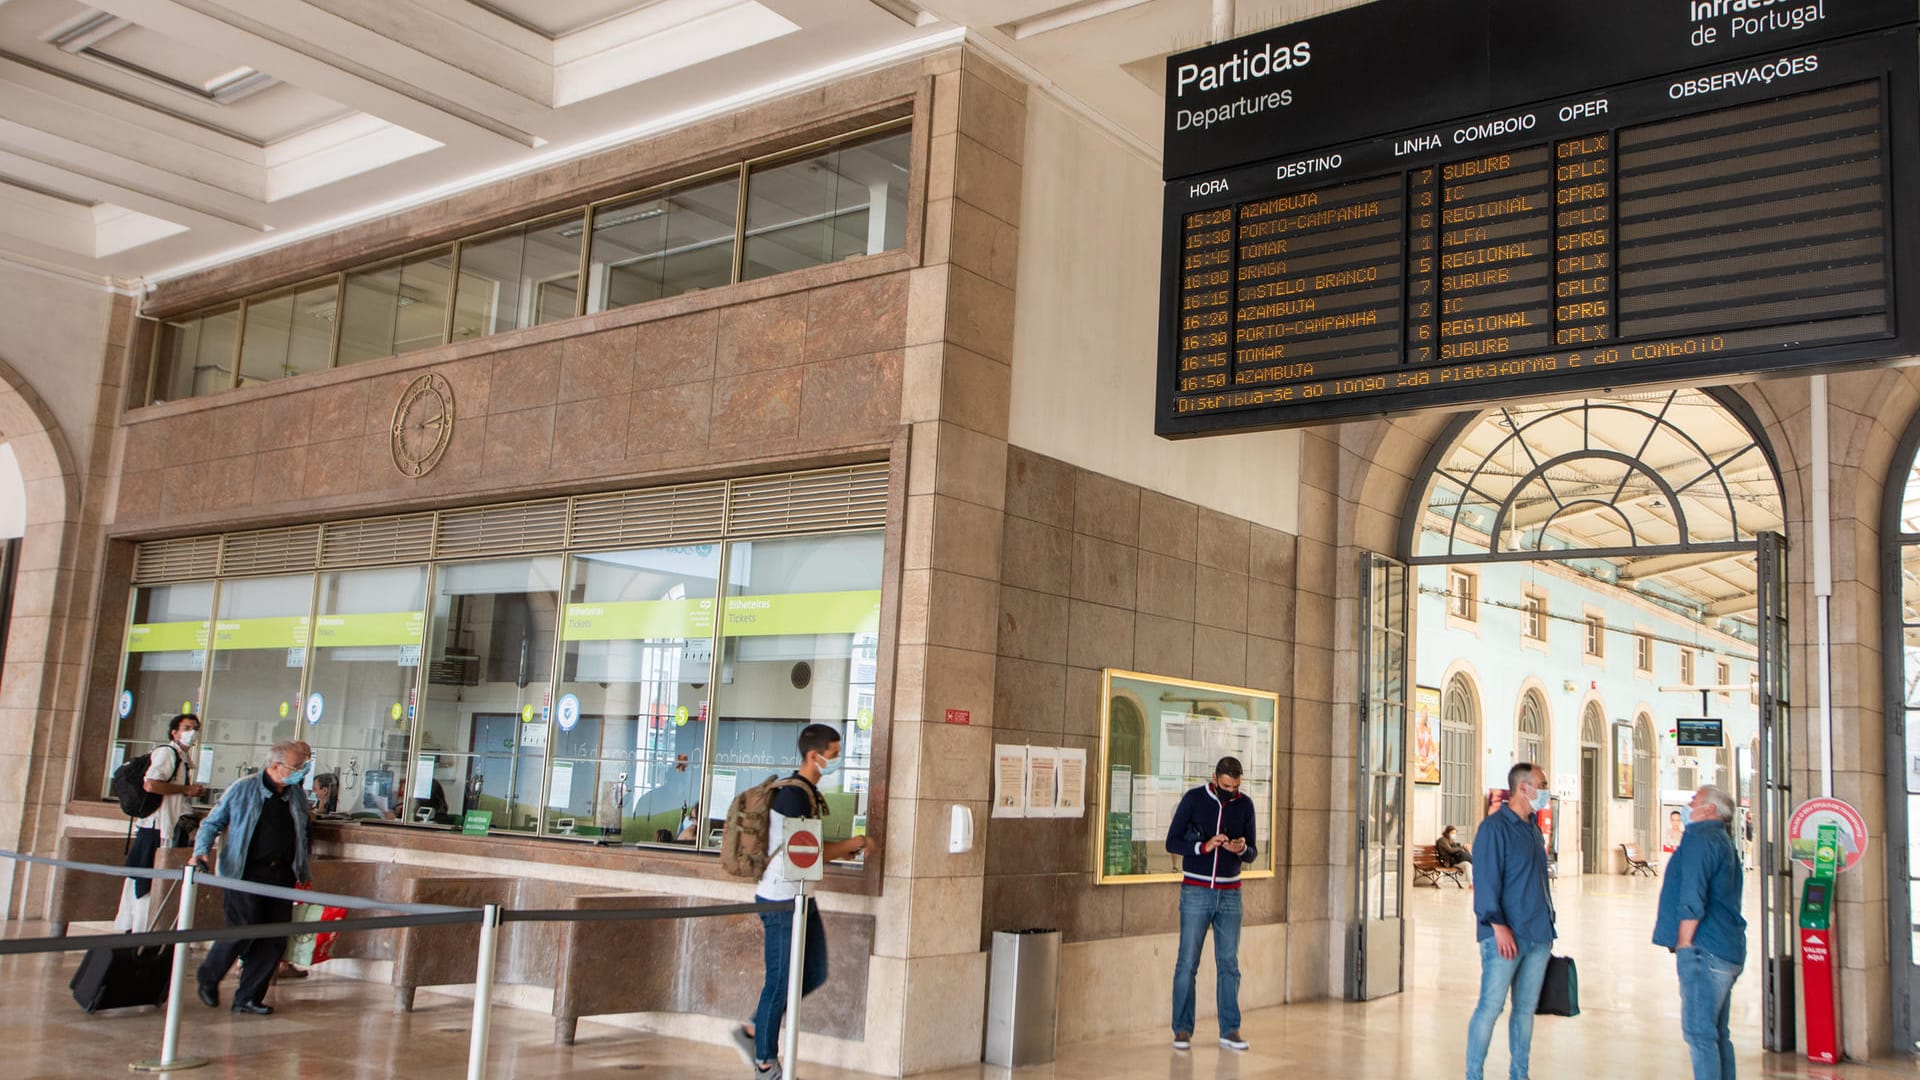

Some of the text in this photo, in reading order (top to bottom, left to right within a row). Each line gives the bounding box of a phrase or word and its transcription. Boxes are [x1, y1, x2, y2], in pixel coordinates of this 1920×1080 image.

[1691, 0, 1826, 47] de Portugal
[1177, 41, 1312, 97] Partidas
[1669, 55, 1818, 99] OBSERVAÇÕES
[1177, 88, 1293, 131] Departures
[1394, 114, 1536, 156] LINHA COMBOIO
[1559, 99, 1608, 122] OPER
[1186, 135, 1605, 229] 15:20 AZAMBUJA 7 SUBURB CPLX
[1190, 179, 1229, 198] HORA
[1277, 155, 1342, 180] DESTINO
[1185, 183, 1605, 269] 15:45 TOMAR 6 REGIONAL CPRG
[1186, 229, 1231, 249] 15:30
[1420, 192, 1432, 206] 3
[1444, 186, 1464, 202] IC
[1557, 159, 1605, 182] CPLC
[1184, 206, 1605, 289] 16:00 BRAGA 1 ALFA CPLC
[1184, 229, 1605, 310] 16:15 CASTELO BRANCO 5 REGIONAL CPRG
[1183, 252, 1606, 330] 16:20 AZAMBUJA 7 SUBURB CPLX
[1183, 332, 1227, 350] 16:30
[1442, 298, 1464, 315] IC
[1557, 276, 1606, 298] CPLC
[1181, 323, 1606, 392] 16:50 AZAMBUJA 7 SUBURB CPLX
[1182, 300, 1606, 371] 16:45 TOMAR 6 REGIONAL CPRG
[1178, 389, 1293, 413] Distribua-se
[1303, 385, 1323, 398] ao
[1335, 377, 1386, 395] longo
[1570, 354, 1580, 367] e
[1594, 350, 1620, 365] do
[729, 613, 756, 624] Tickets
